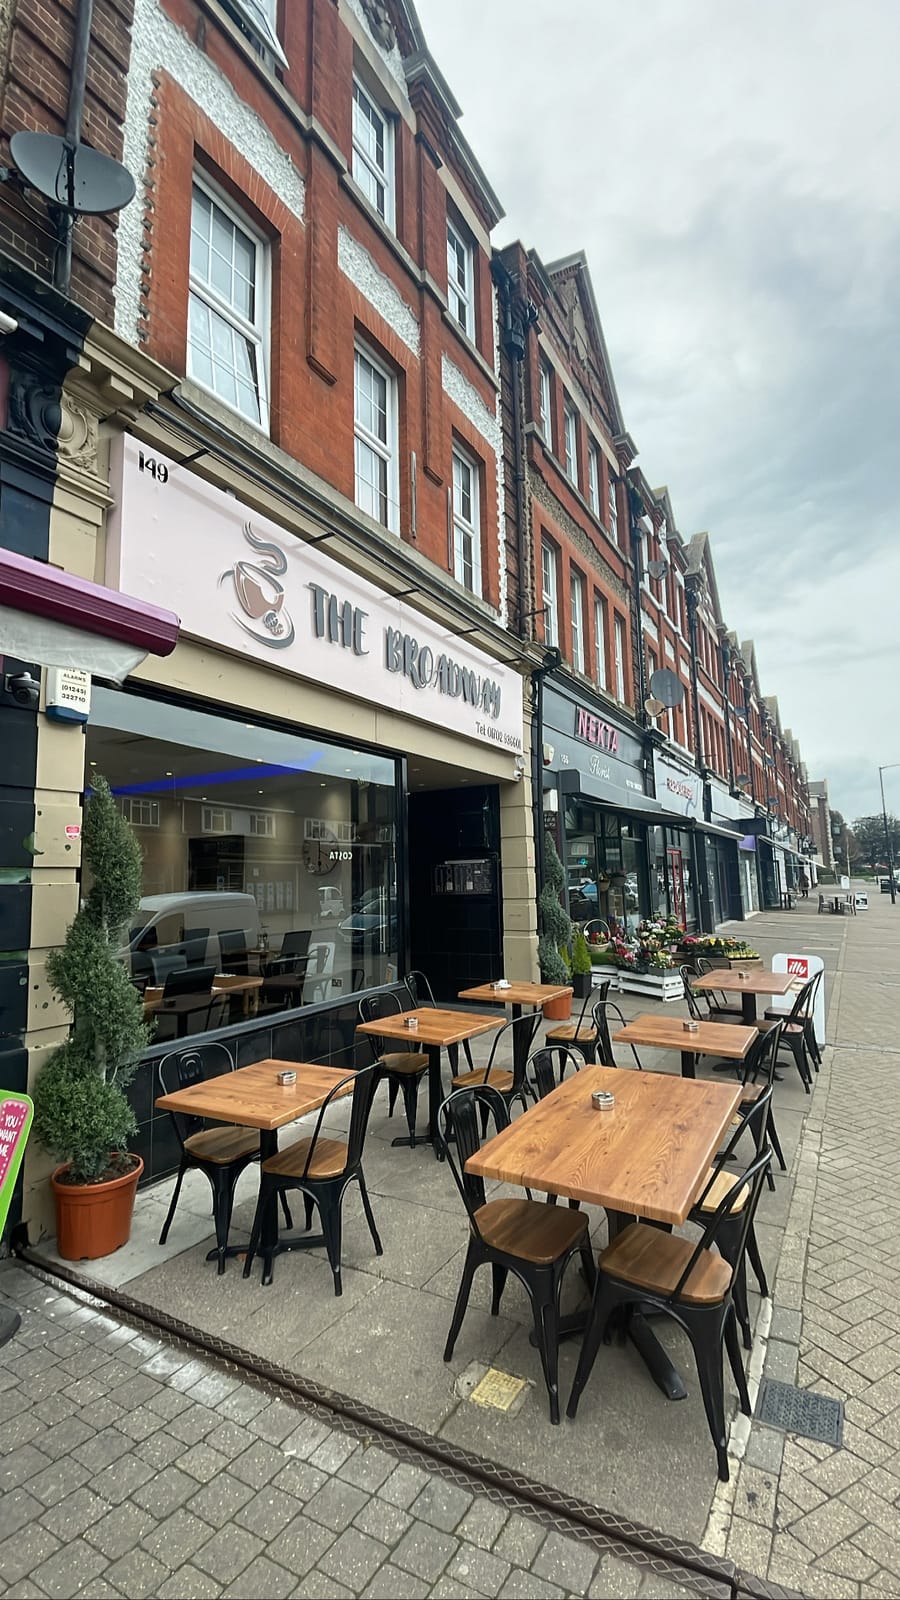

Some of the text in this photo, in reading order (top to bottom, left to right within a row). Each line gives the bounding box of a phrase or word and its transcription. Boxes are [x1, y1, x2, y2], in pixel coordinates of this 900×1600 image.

[139, 450, 169, 483] 149
[307, 582, 501, 719] THE BROADWAY
[63, 673, 86, 682] ALARMS
[62, 684, 87, 695] (01245)
[578, 709, 618, 753] NEKTA
[788, 961, 807, 976] illy
[5, 1114, 19, 1128] YOU
